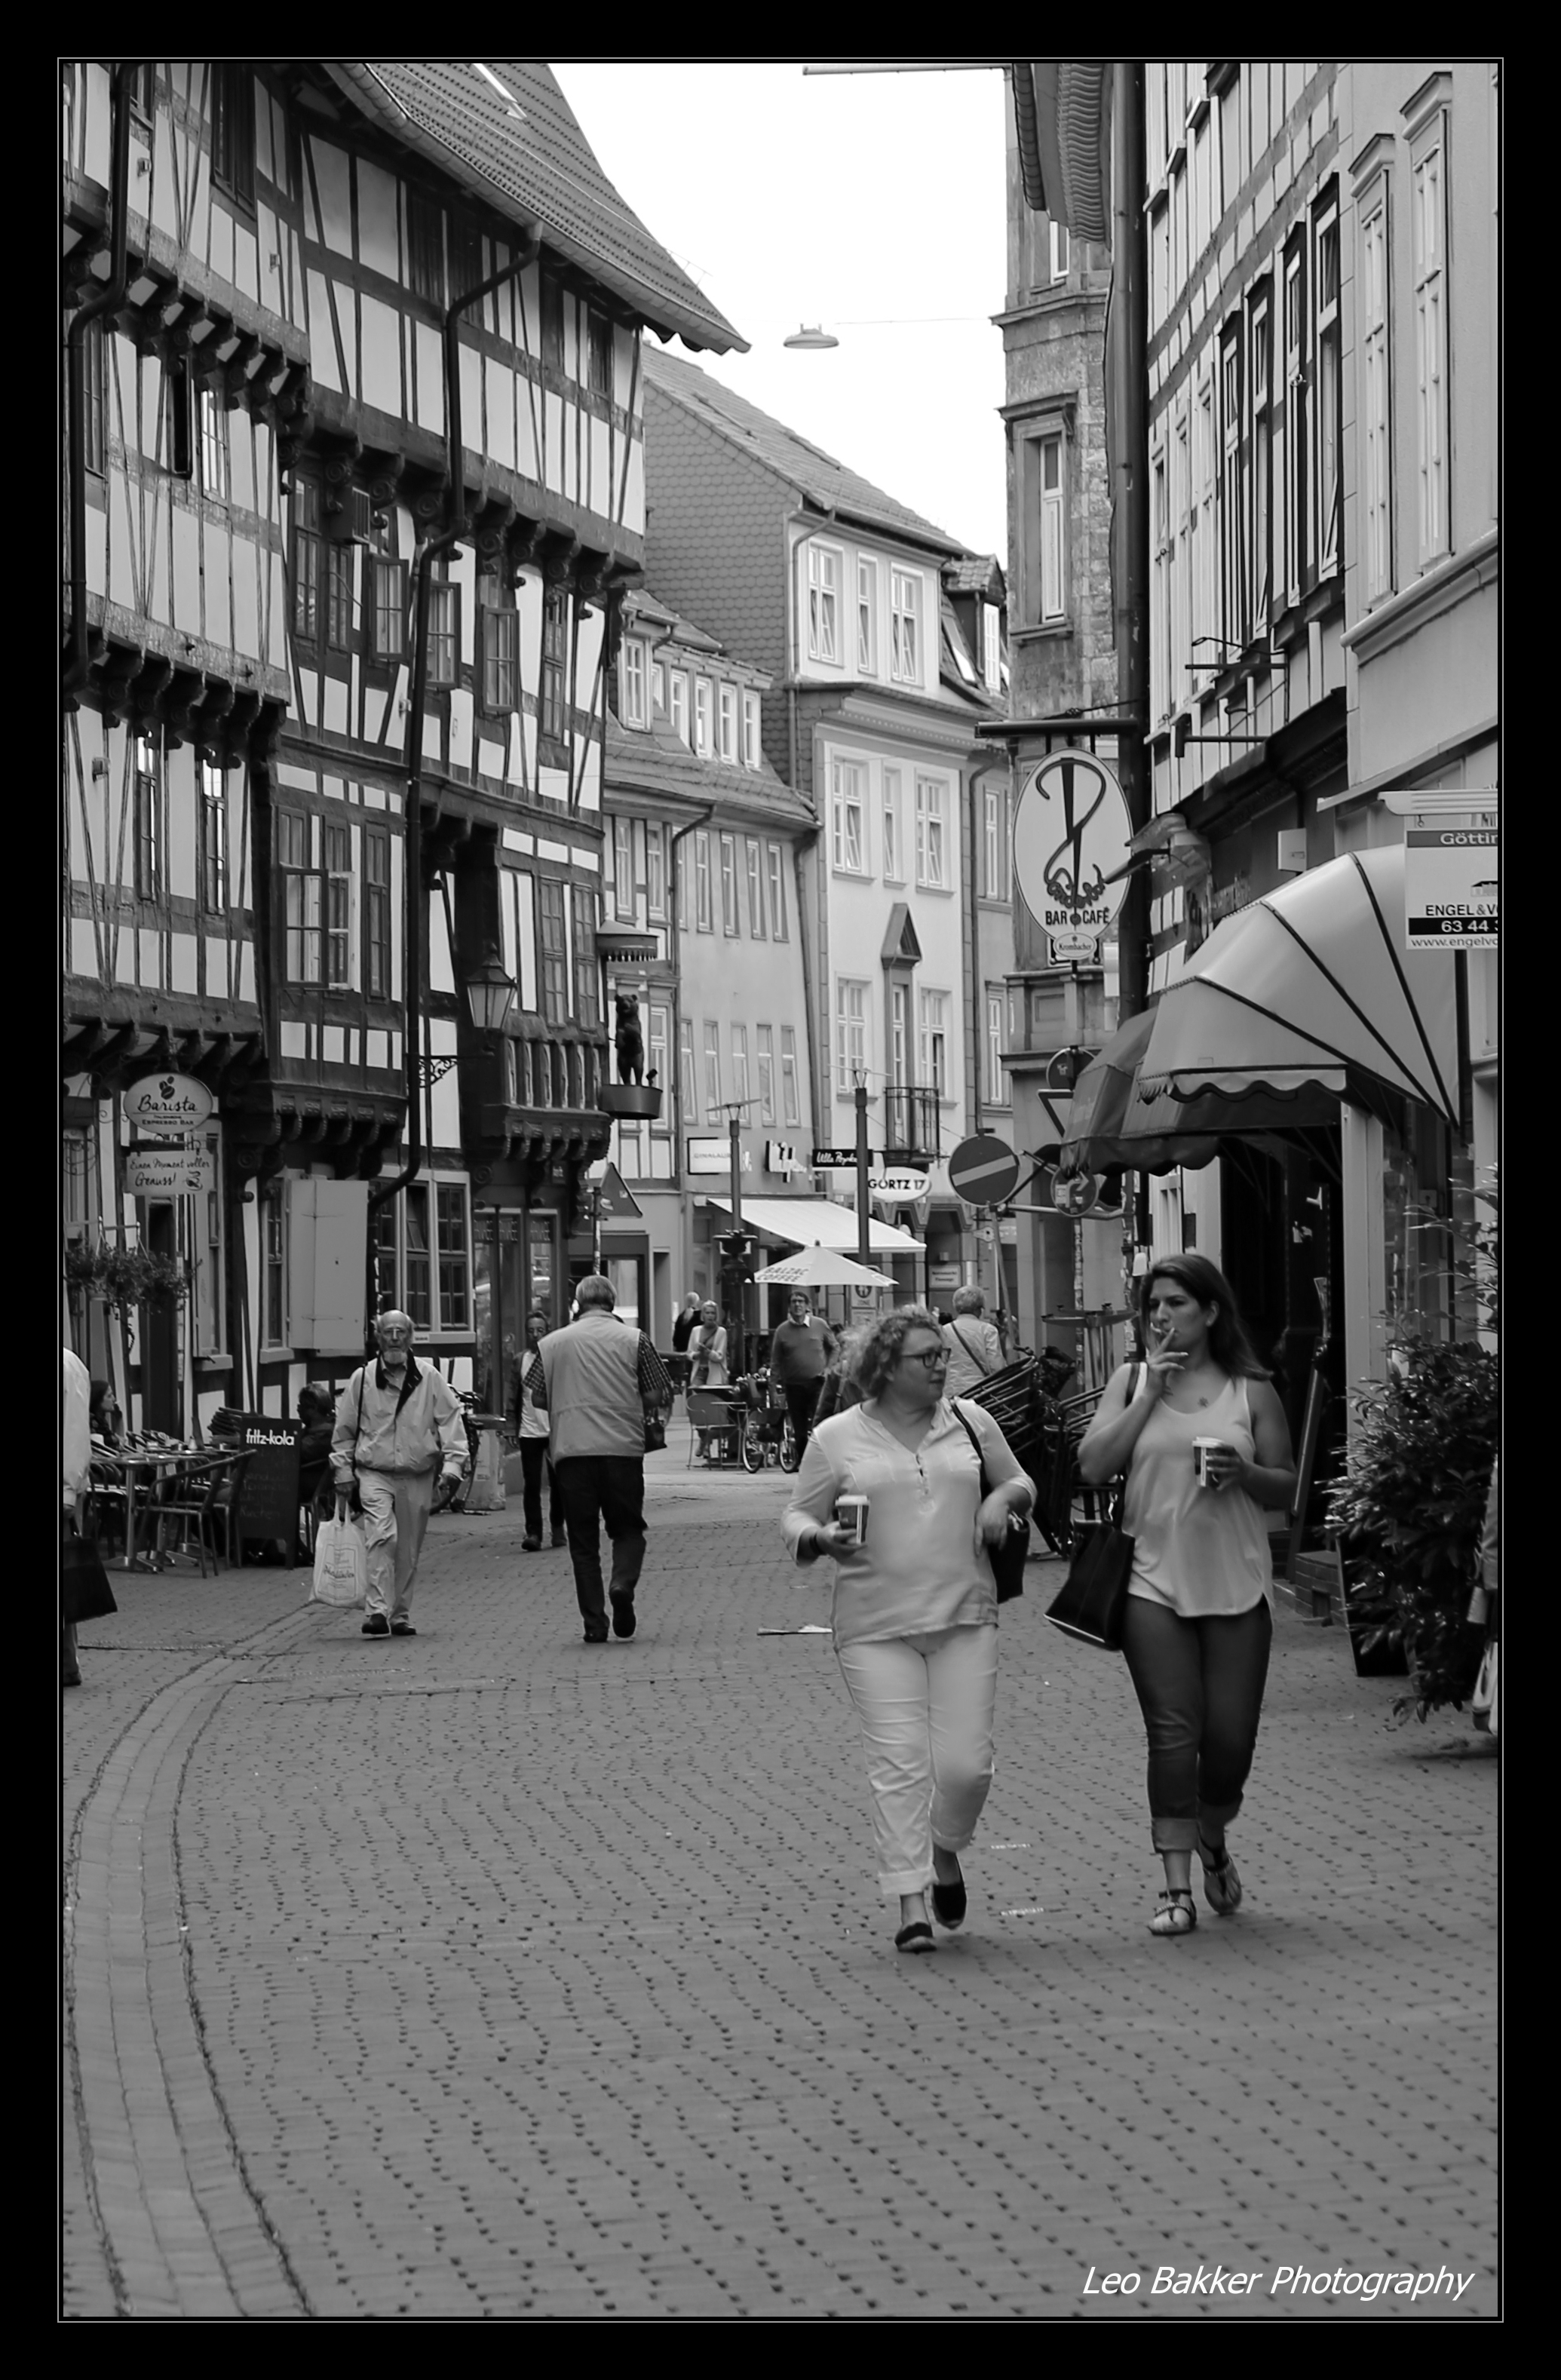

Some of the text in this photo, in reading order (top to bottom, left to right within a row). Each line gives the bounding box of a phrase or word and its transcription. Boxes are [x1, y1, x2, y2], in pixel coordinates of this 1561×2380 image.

[1045, 906, 1110, 925] BAR CAFÉ
[1440, 920, 1463, 933] 63
[1467, 919, 1489, 932] 44
[137, 1094, 198, 1112] Barista
[152, 1158, 184, 1169] Moment
[186, 1157, 210, 1168] voller
[816, 1151, 857, 1166] Ulla Popke
[913, 1179, 926, 1189] 17
[756, 1274, 801, 1282] COFFEE
[764, 1267, 809, 1276] BALZAC
[245, 1428, 295, 1446] fritz-kola
